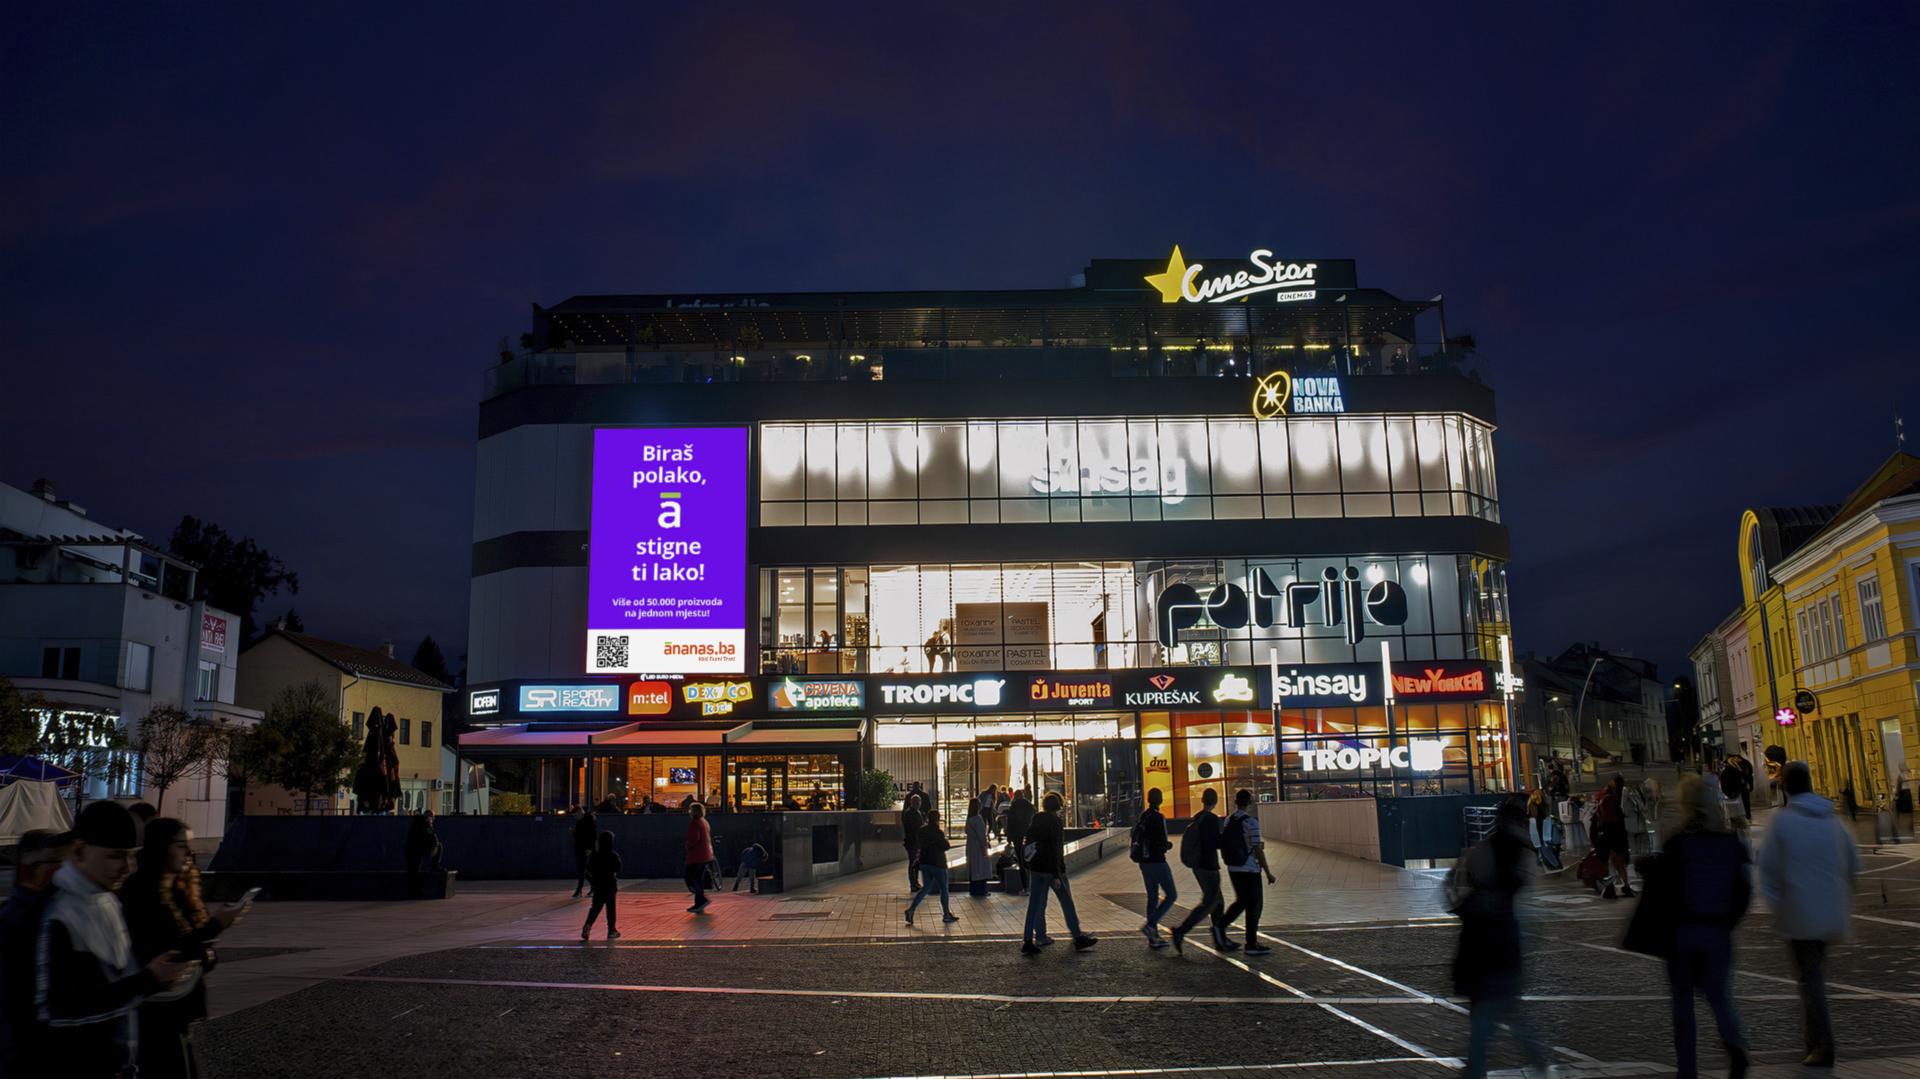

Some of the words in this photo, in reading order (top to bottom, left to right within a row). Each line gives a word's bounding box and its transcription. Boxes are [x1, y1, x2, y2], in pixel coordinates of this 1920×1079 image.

[1181, 249, 1317, 303] CineStar
[1279, 291, 1313, 301] CINEMAS
[1292, 377, 1341, 397] NOVA
[1293, 397, 1345, 413] BANKA
[643, 444, 693, 461] Biraš
[633, 466, 707, 488] polako,
[636, 537, 701, 560] stigne
[632, 563, 647, 581] ti
[654, 563, 705, 581] lako!
[612, 598, 632, 607] Više
[633, 598, 645, 607] od
[647, 598, 676, 607] 50.000
[677, 598, 723, 609] proizvoda
[625, 609, 636, 618] na
[637, 609, 673, 619] jednom
[676, 609, 710, 619] mjestu!
[1006, 649, 1046, 657] PASTEL
[728, 685, 748, 698] CO
[803, 683, 858, 697] CRVENA
[1051, 682, 1111, 699] Juventa
[1278, 670, 1367, 702] sinsay
[562, 689, 604, 699] SPORT
[633, 691, 668, 704] m:tel
[881, 684, 973, 704] TROPIC
[1125, 689, 1201, 705] KUPREŠAK
[562, 698, 613, 707] REALITY
[805, 695, 859, 710] apoteka
[1068, 698, 1095, 706] SPORT
[1150, 756, 1167, 767] dm
[1298, 746, 1409, 771] TROPIC
